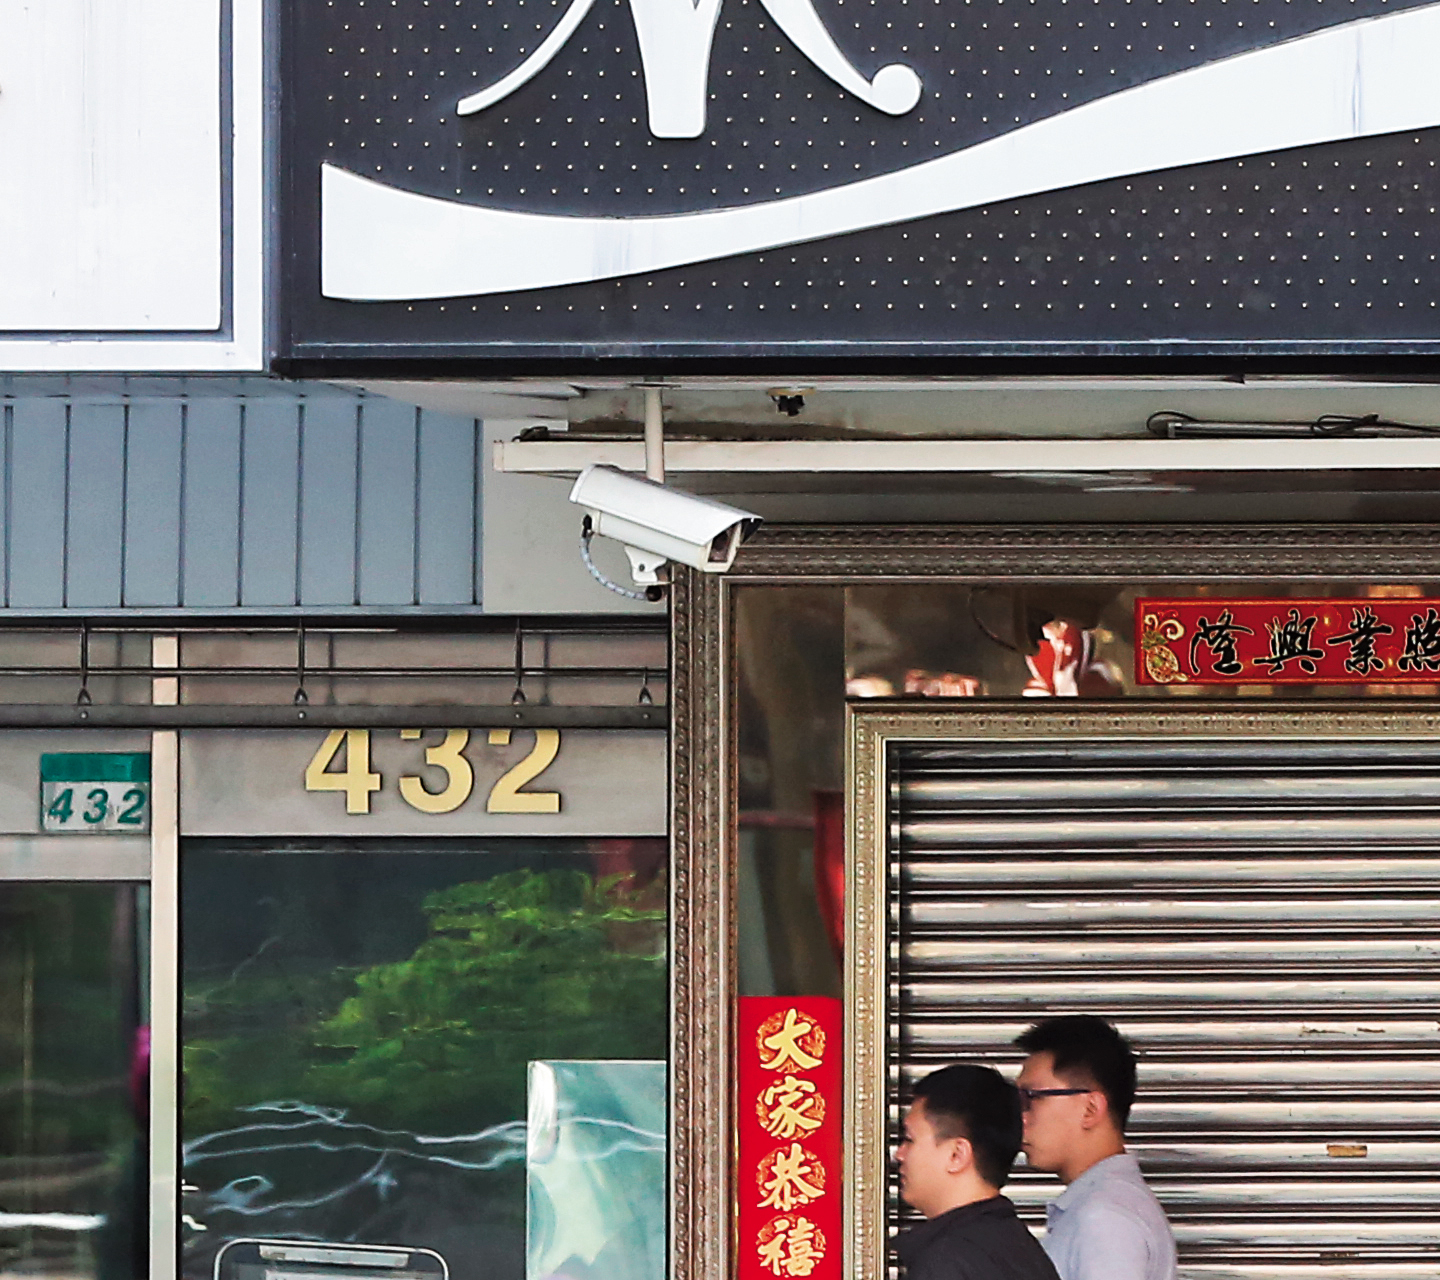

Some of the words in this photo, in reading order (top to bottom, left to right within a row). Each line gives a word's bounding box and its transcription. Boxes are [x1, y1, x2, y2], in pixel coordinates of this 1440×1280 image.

[48, 788, 146, 824] 432
[305, 729, 561, 814] 432
[756, 1008, 827, 1277] 大家恭禧
